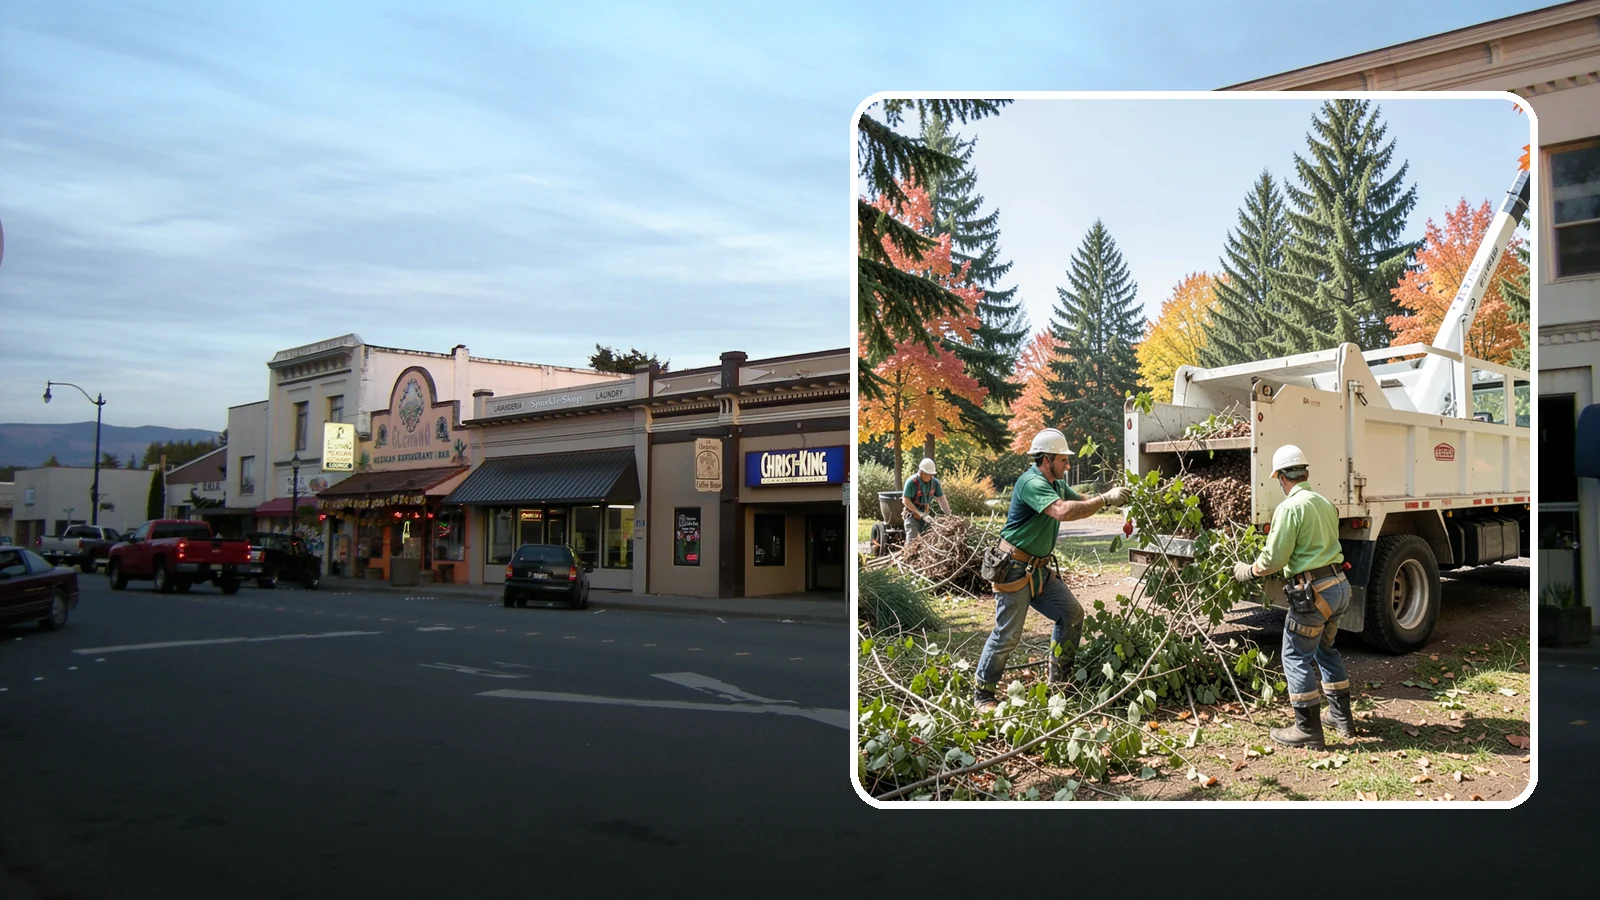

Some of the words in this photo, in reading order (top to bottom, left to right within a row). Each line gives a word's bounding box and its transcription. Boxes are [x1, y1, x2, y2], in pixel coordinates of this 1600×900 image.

[561, 395, 583, 405] Shop
[595, 389, 623, 400] LAUNDRY
[493, 402, 522, 412] LAVANDERIA
[373, 455, 396, 464] MEXICAN
[397, 451, 433, 462] RESTAURANT
[438, 450, 450, 459] BAR
[760, 452, 797, 478] CHRIST
[799, 449, 827, 476] KING
